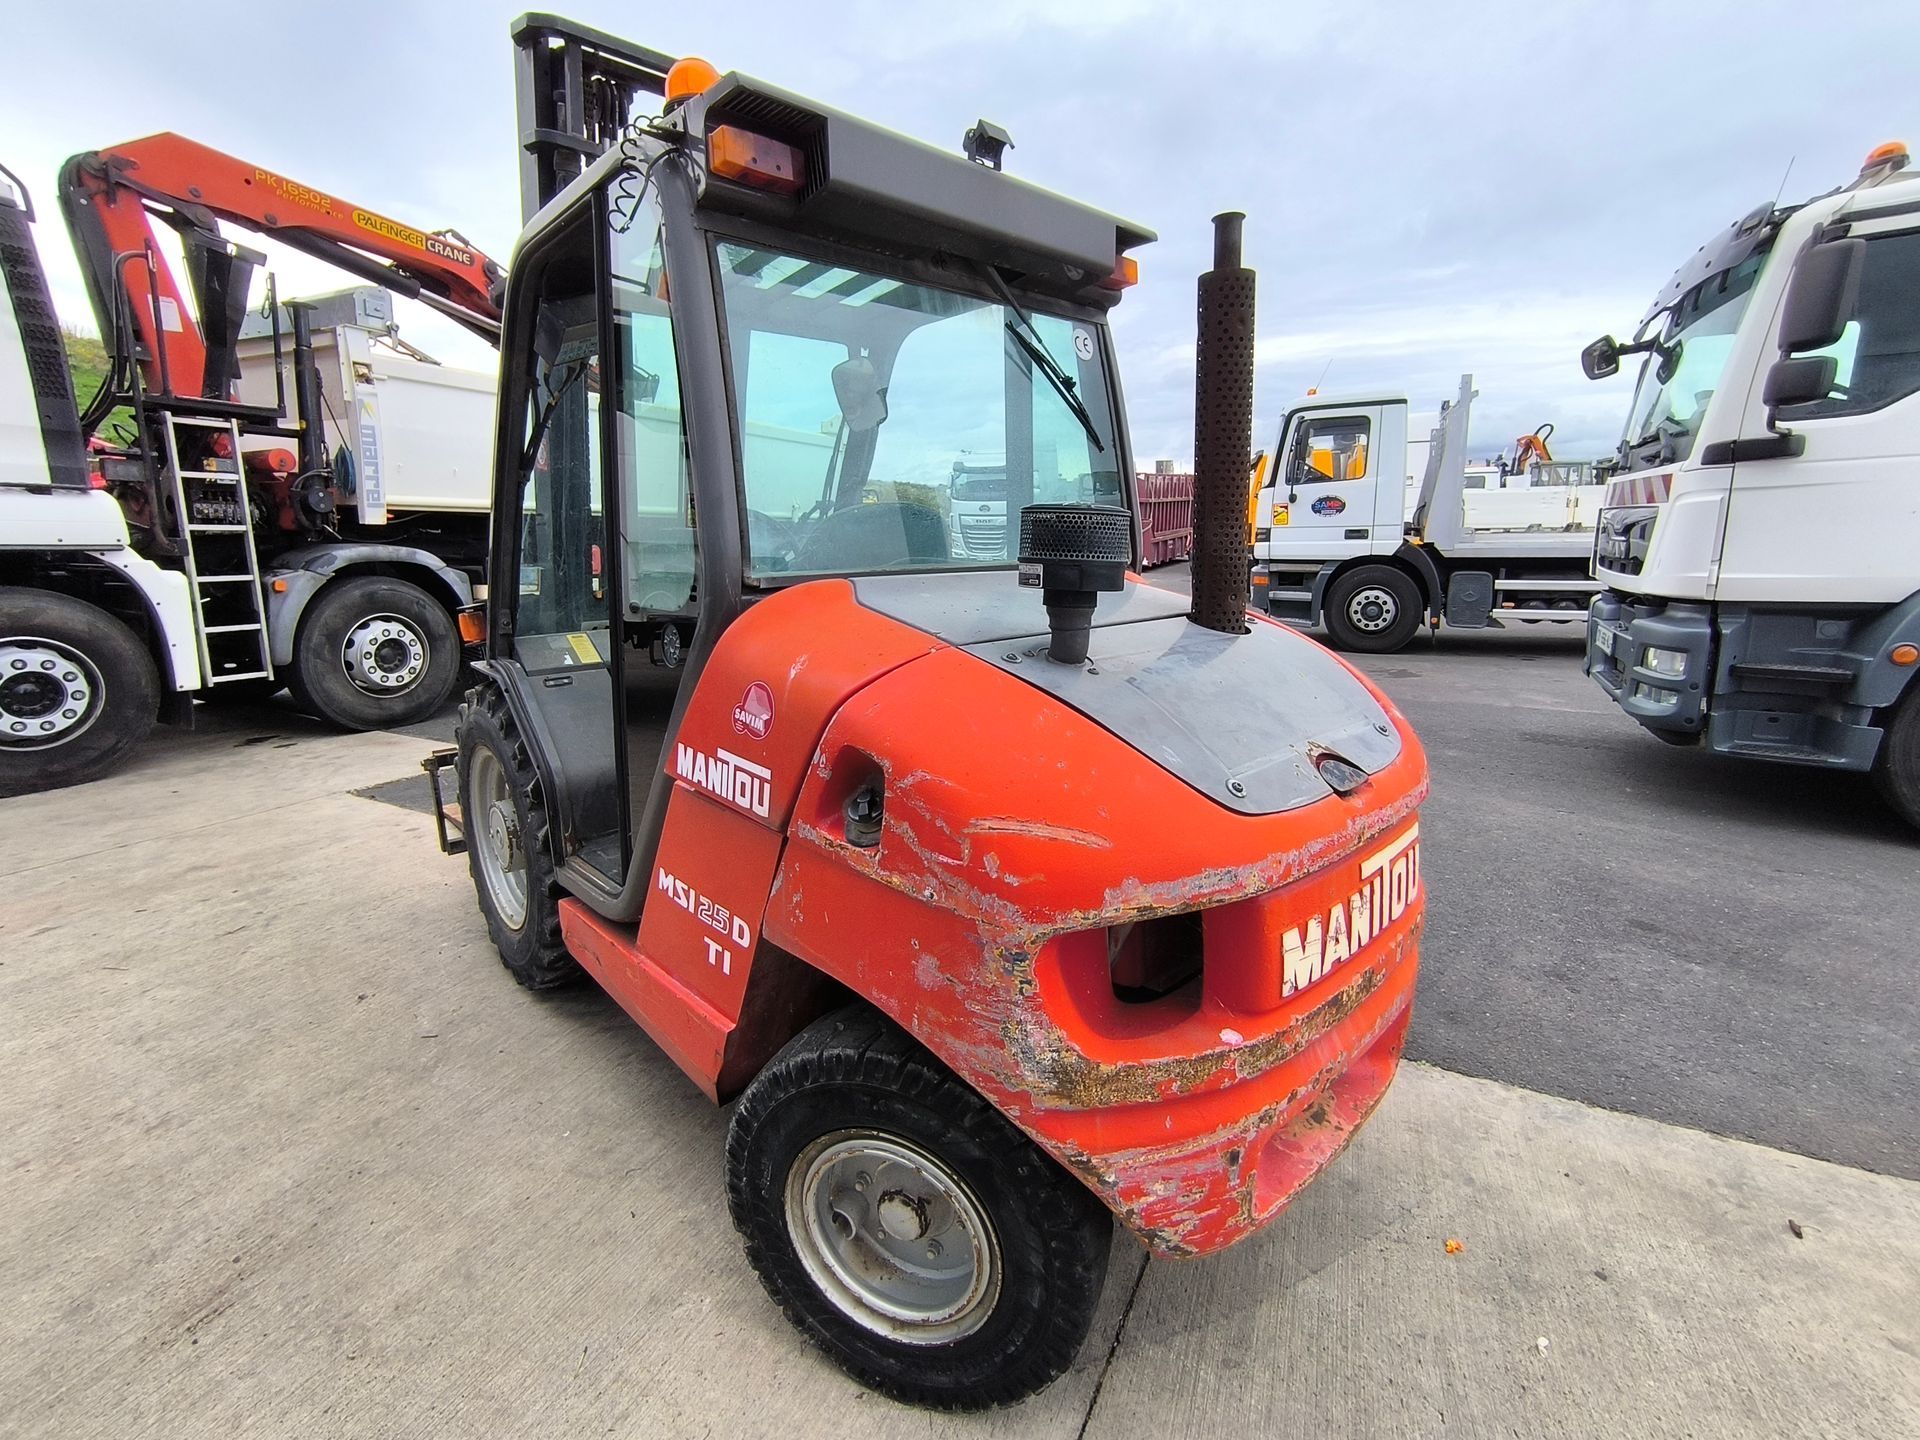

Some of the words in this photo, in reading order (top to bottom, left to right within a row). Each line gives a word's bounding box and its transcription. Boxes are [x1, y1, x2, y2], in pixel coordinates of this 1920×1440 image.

[255, 169, 277, 187] PK
[283, 181, 331, 207] 16502
[357, 212, 424, 247] PALFINGER
[427, 239, 470, 265] CRANE
[1075, 335, 1091, 354] CE
[361, 425, 386, 508] marrel
[734, 708, 764, 731] SAVIM
[676, 742, 772, 818] MANITOU
[1282, 821, 1420, 998] MANITOU
